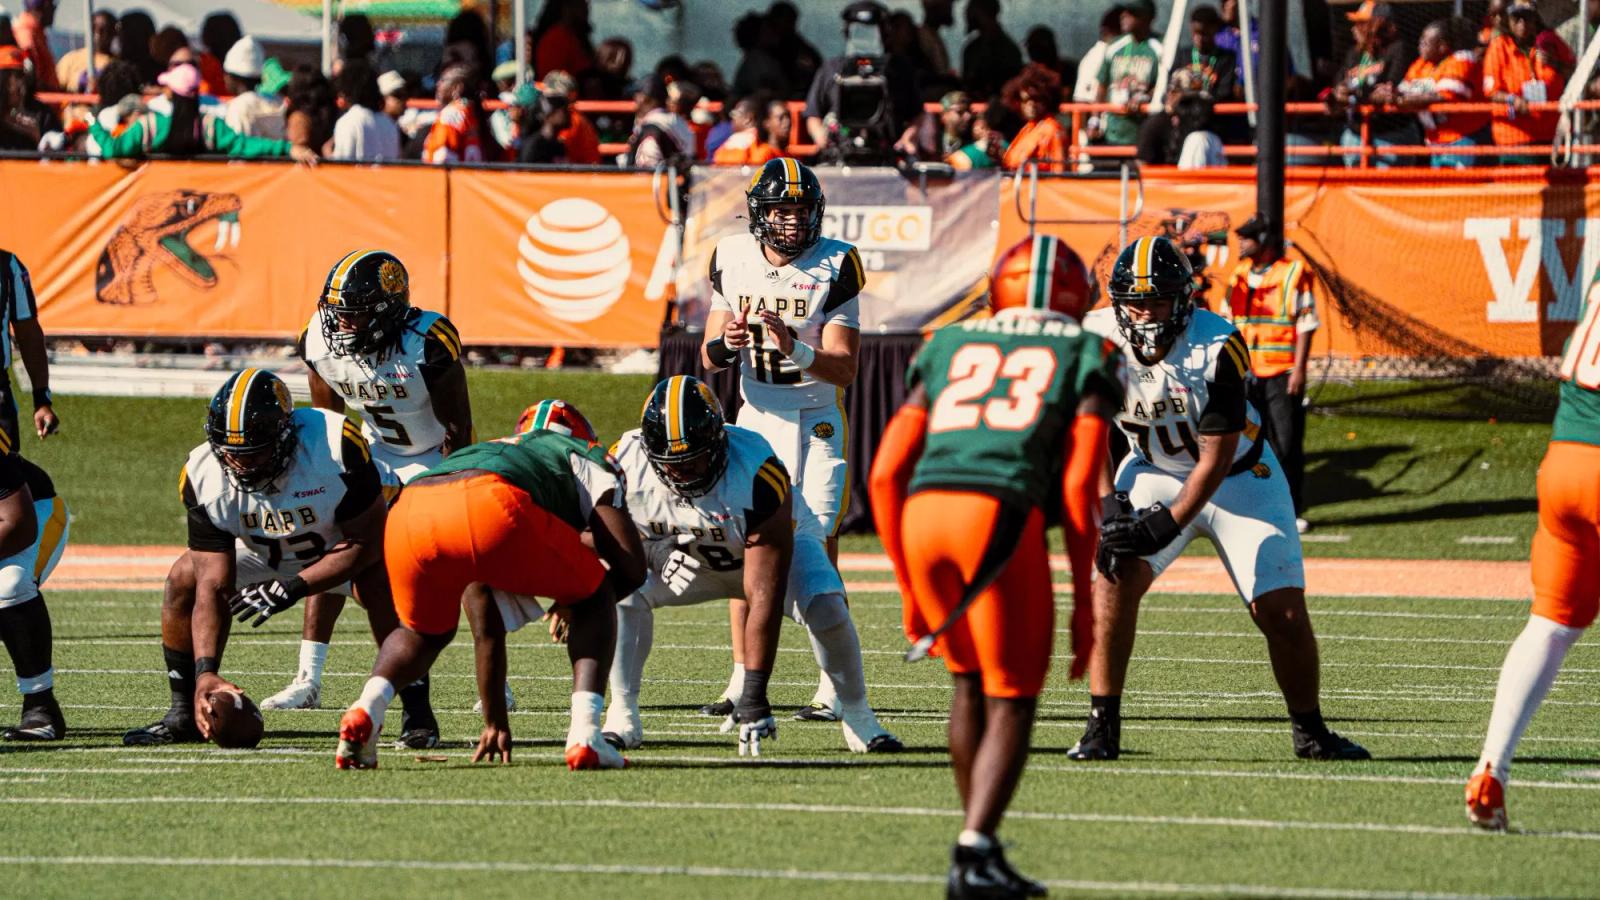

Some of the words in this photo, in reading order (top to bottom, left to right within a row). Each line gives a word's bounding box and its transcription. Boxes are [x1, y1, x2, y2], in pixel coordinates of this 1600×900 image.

[738, 294, 808, 319] UAPB
[338, 382, 408, 400] UAPB
[929, 342, 1059, 435] 23
[364, 405, 413, 446] 5
[1120, 420, 1201, 464] 74
[301, 486, 326, 498] SWAC
[242, 506, 318, 531] UAPB
